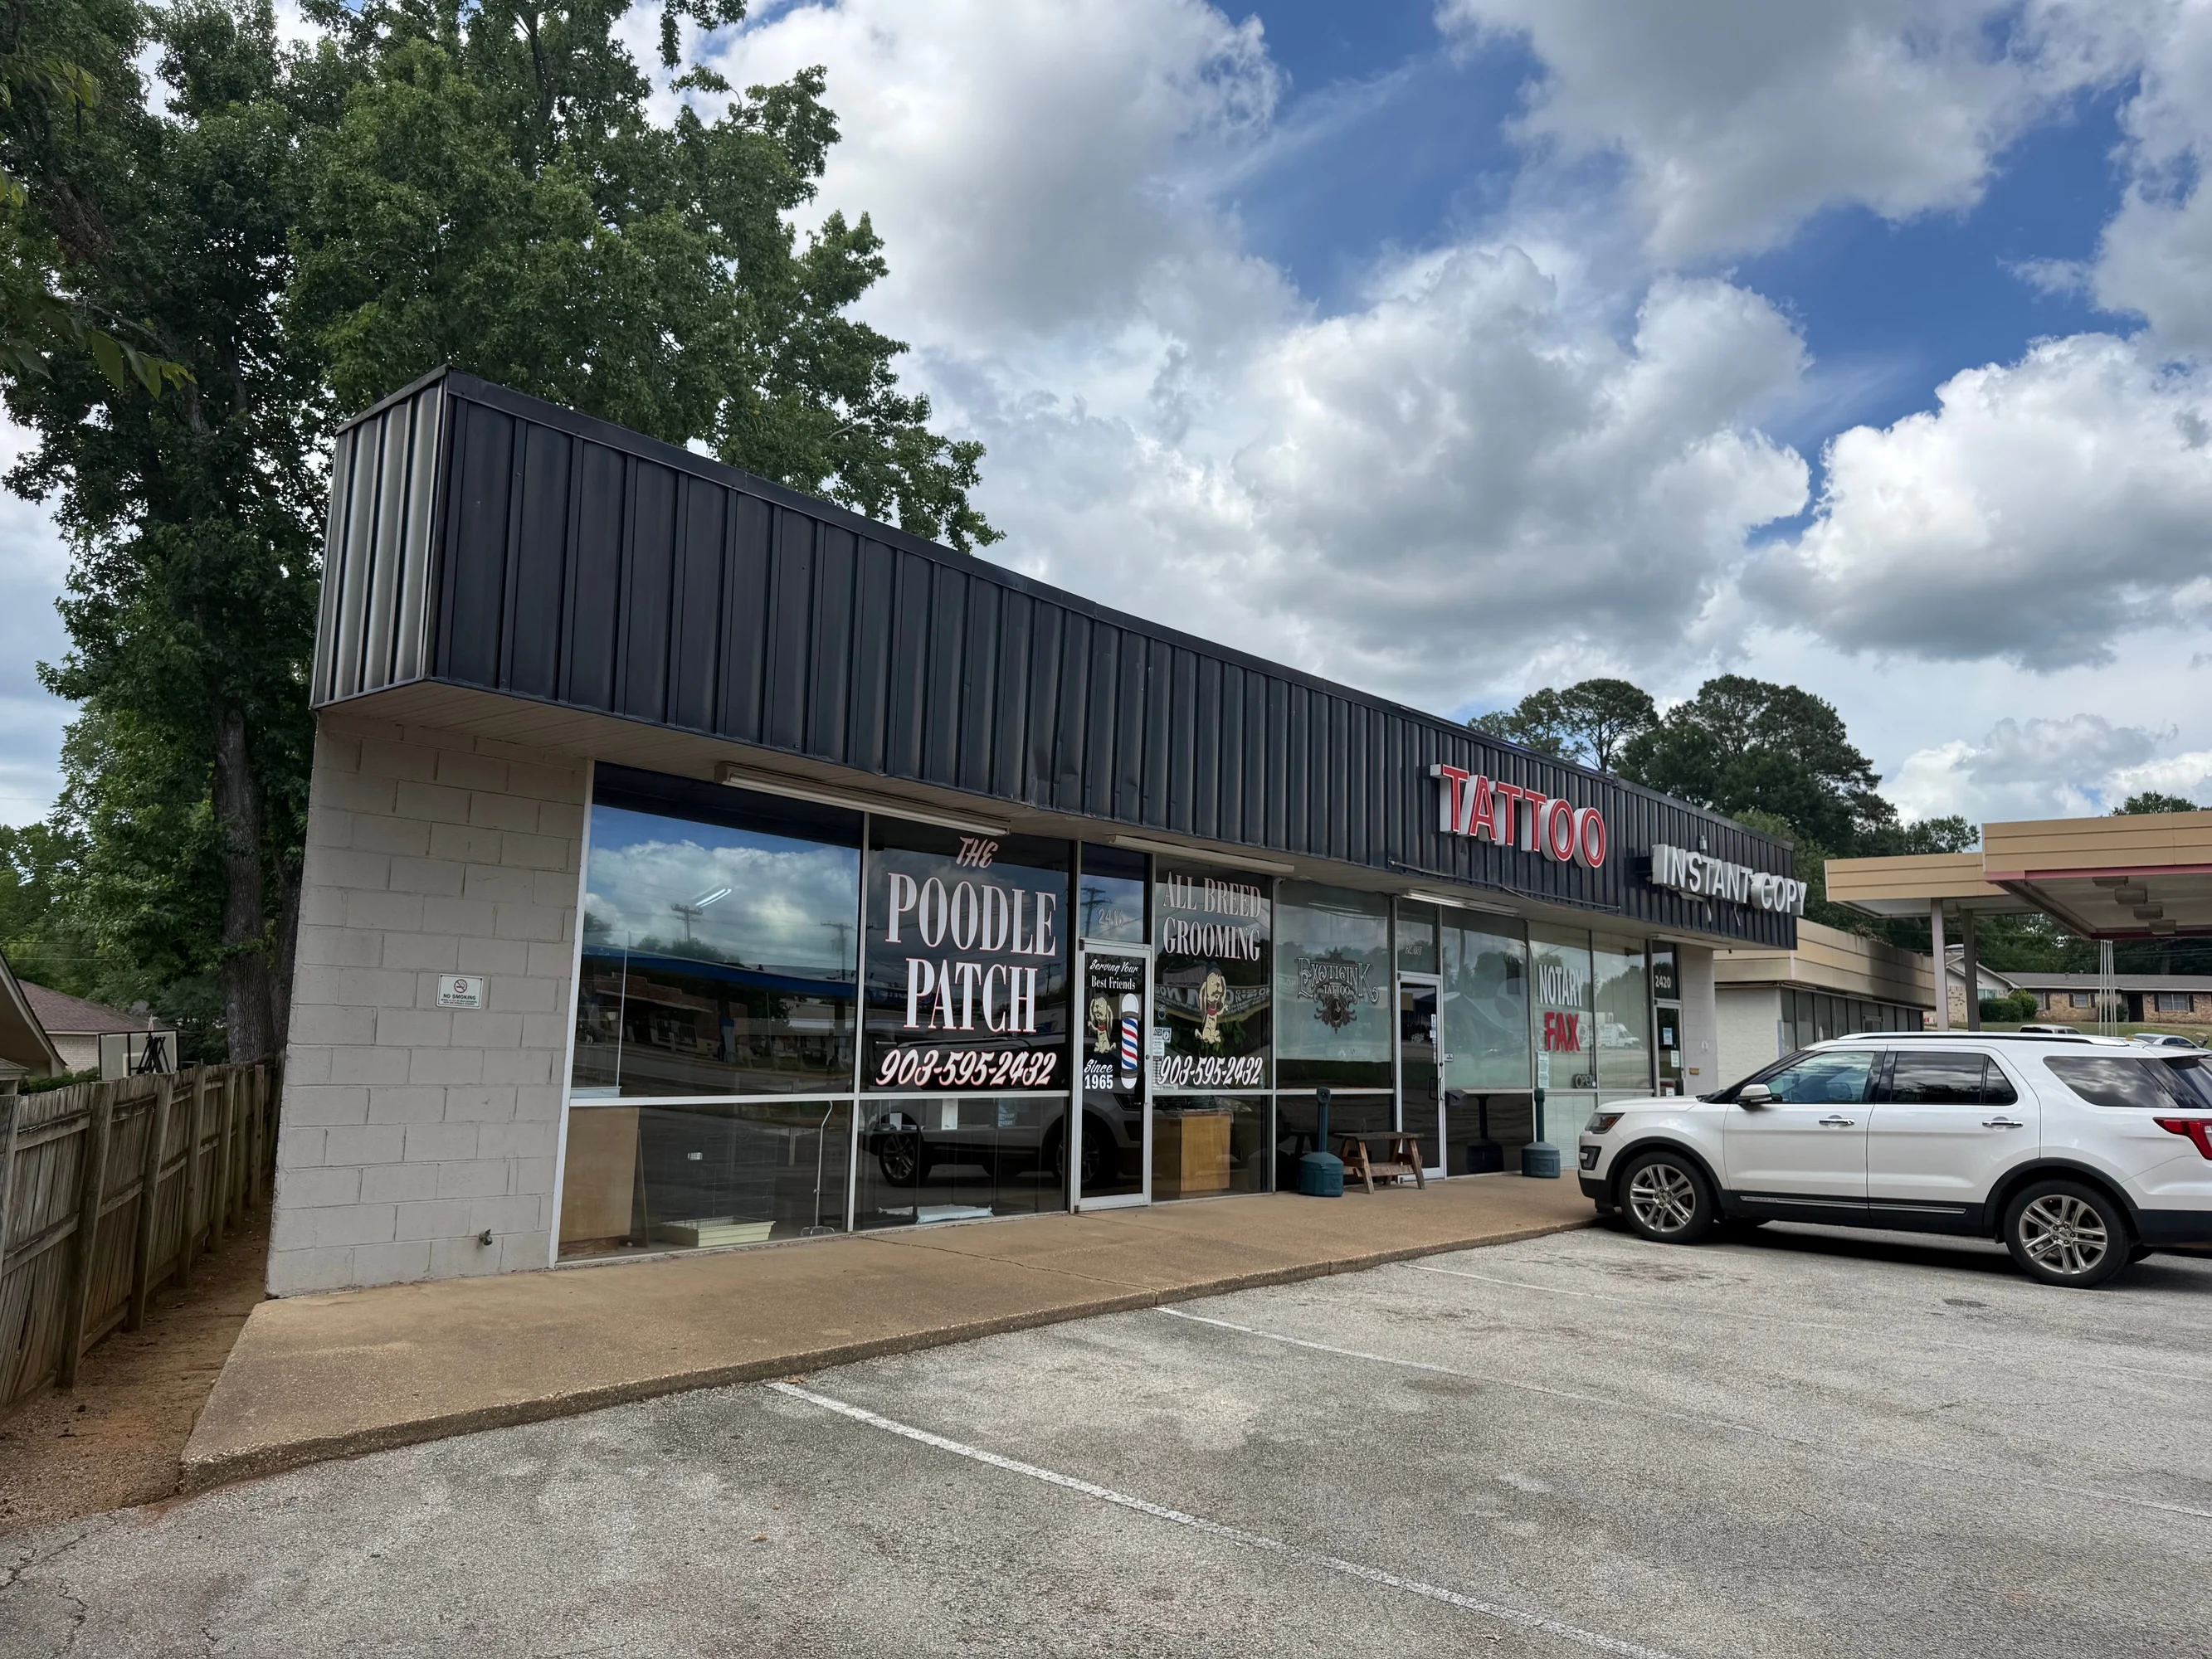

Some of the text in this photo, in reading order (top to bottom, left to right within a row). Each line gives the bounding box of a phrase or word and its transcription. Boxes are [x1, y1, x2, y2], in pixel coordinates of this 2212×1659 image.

[1430, 763, 1606, 868] TATTOO
[956, 835, 999, 868] THE
[1162, 871, 1262, 918] ALL BREED
[1652, 844, 1807, 916] INSTANT COPY
[884, 872, 1056, 956] POODLE
[1098, 907, 1123, 928] 2416
[1162, 916, 1261, 962] GROOMING
[1089, 959, 1139, 975] Serving Your
[1091, 975, 1136, 990] Best Friends
[1654, 974, 1672, 990] 2420
[903, 957, 1038, 1034] PATCH
[1323, 984, 1351, 995] TATTOO
[1538, 964, 1584, 1007] NOTARY
[1544, 1011, 1581, 1052] FAX
[875, 1048, 1058, 1087] 903-595-2432
[1084, 1058, 1113, 1073] Since
[1084, 1074, 1113, 1090] 1965
[1157, 1055, 1264, 1086] 903-595-2432
